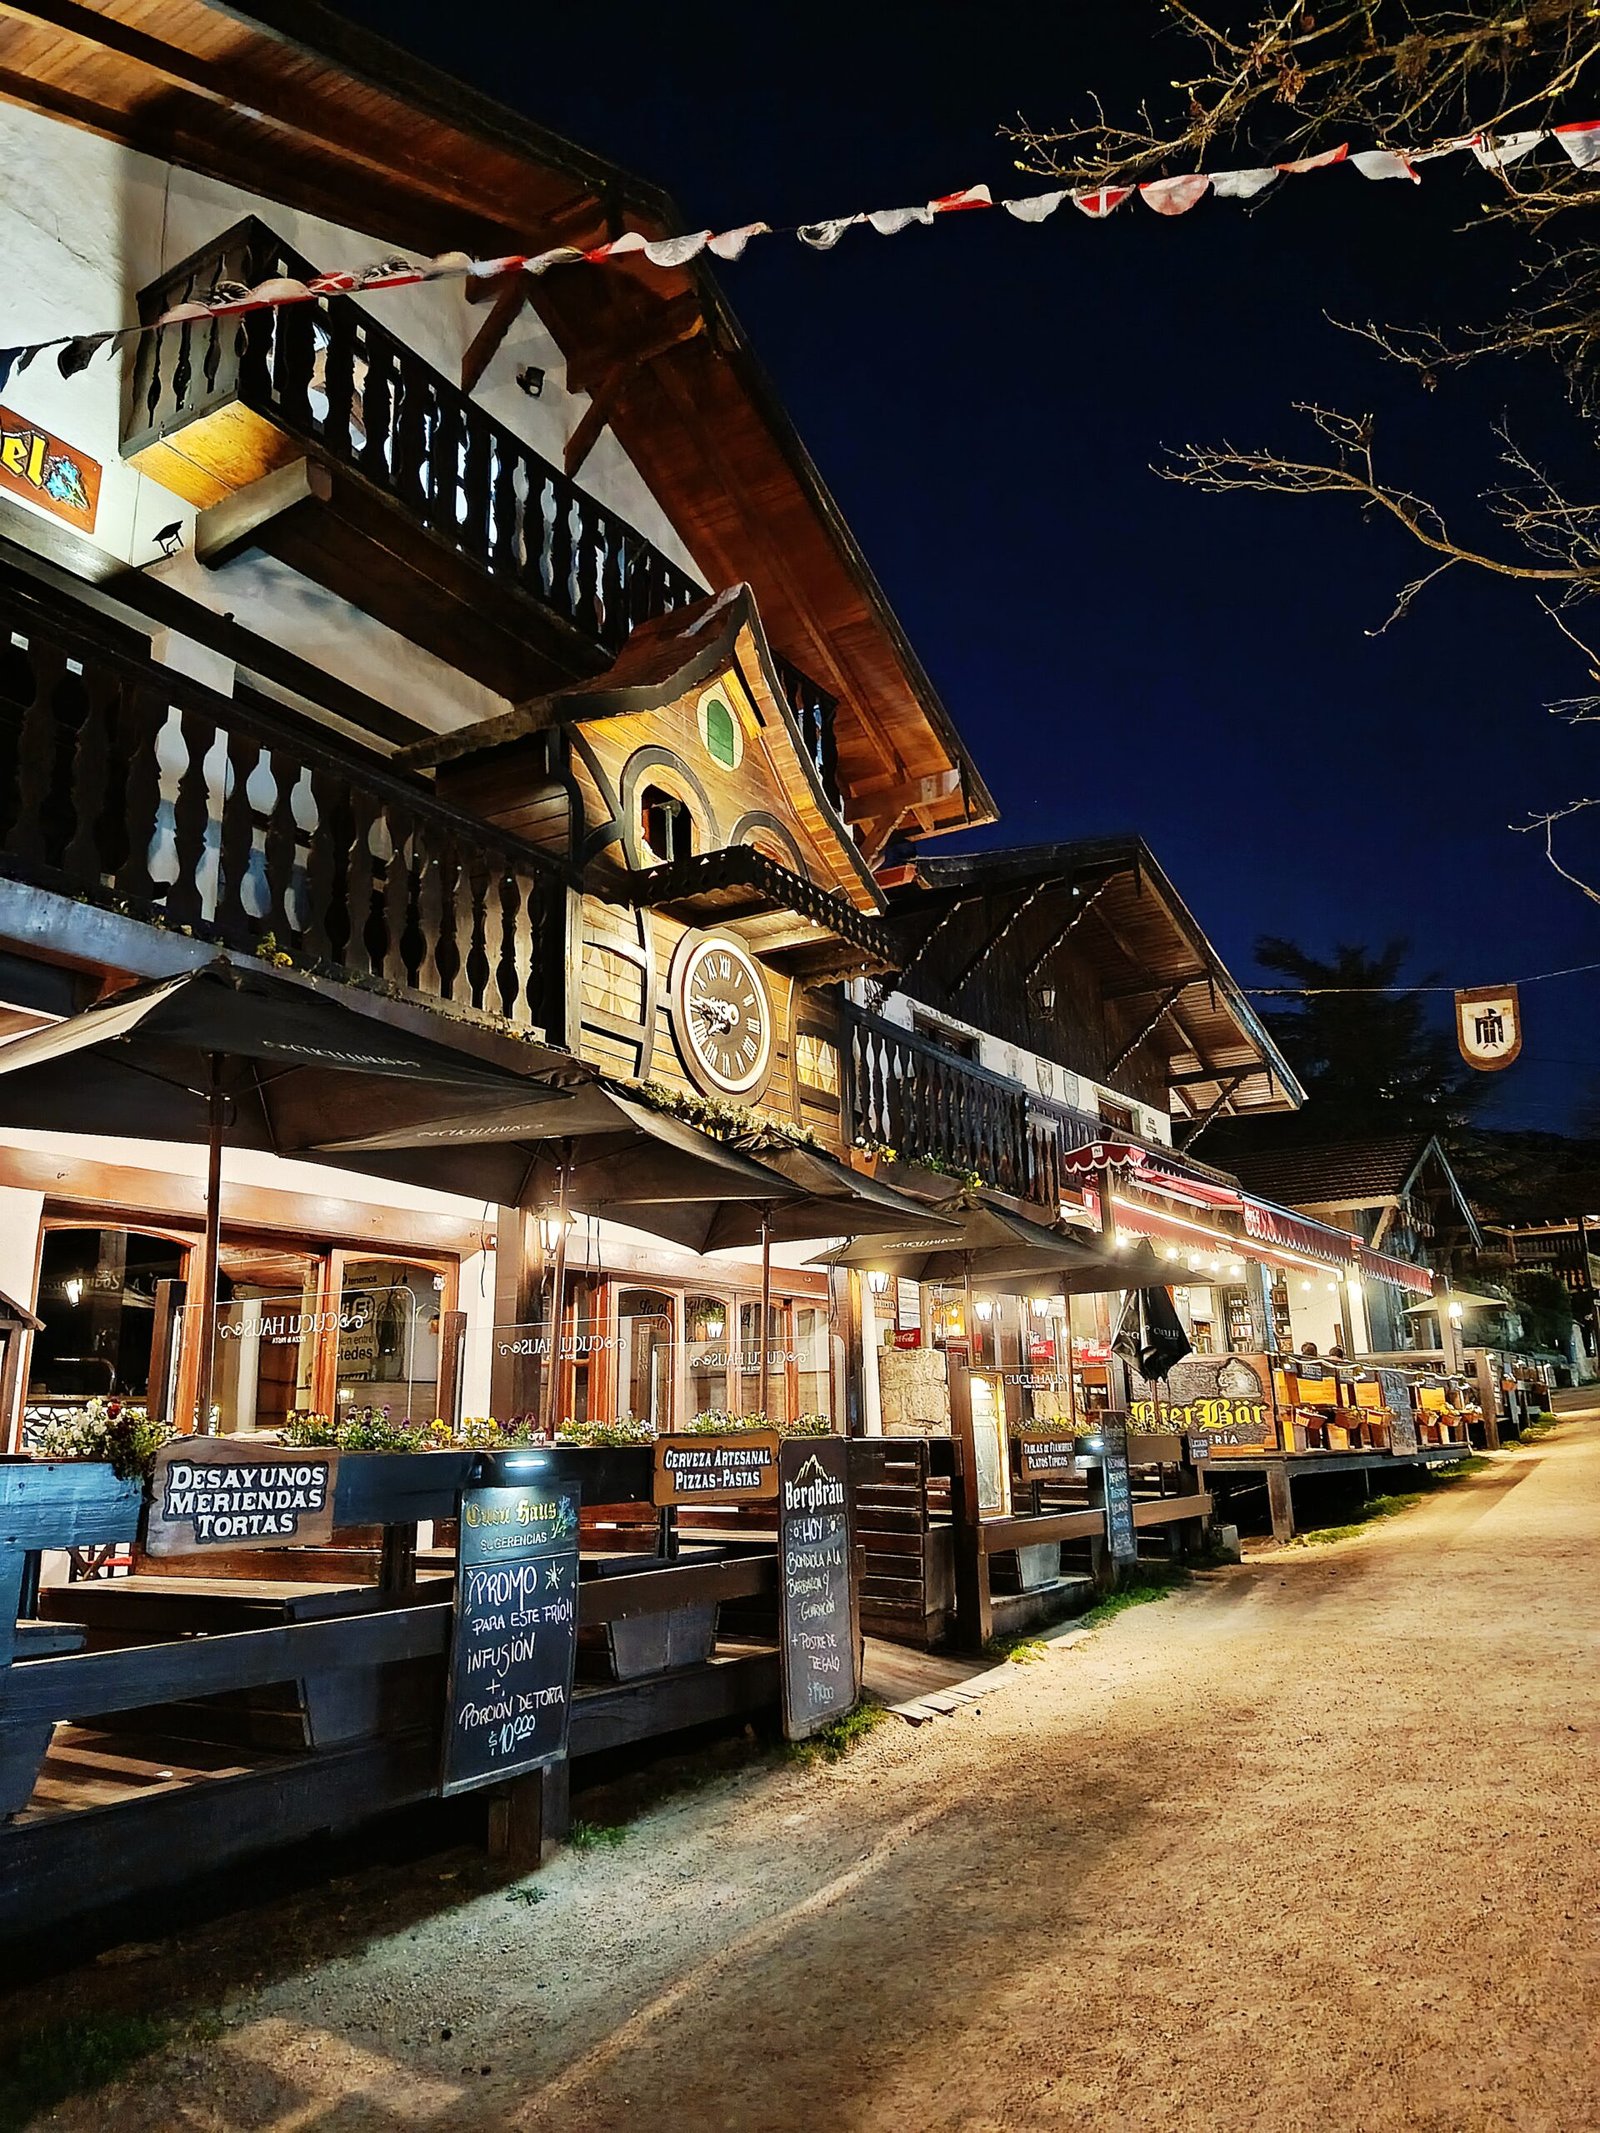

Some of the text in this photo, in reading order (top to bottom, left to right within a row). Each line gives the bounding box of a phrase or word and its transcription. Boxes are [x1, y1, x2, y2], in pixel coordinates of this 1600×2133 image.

[1130, 1398, 1268, 1434] BierBär
[665, 1449, 771, 1469] CERVEZA ARTESANAL
[170, 1465, 327, 1490] DESAYUNOS
[675, 1468, 761, 1490] PIZZAS-PASTAS
[168, 1488, 323, 1515] MERIENDAS
[784, 1476, 844, 1514] BergBräu
[197, 1513, 294, 1538] TORTAS
[515, 1499, 557, 1526] Haus
[803, 1517, 823, 1543] HOY
[468, 1565, 538, 1612] PROMO
[472, 1613, 506, 1637] PARA
[510, 1608, 541, 1628] ESTE
[485, 1678, 501, 1695] +
